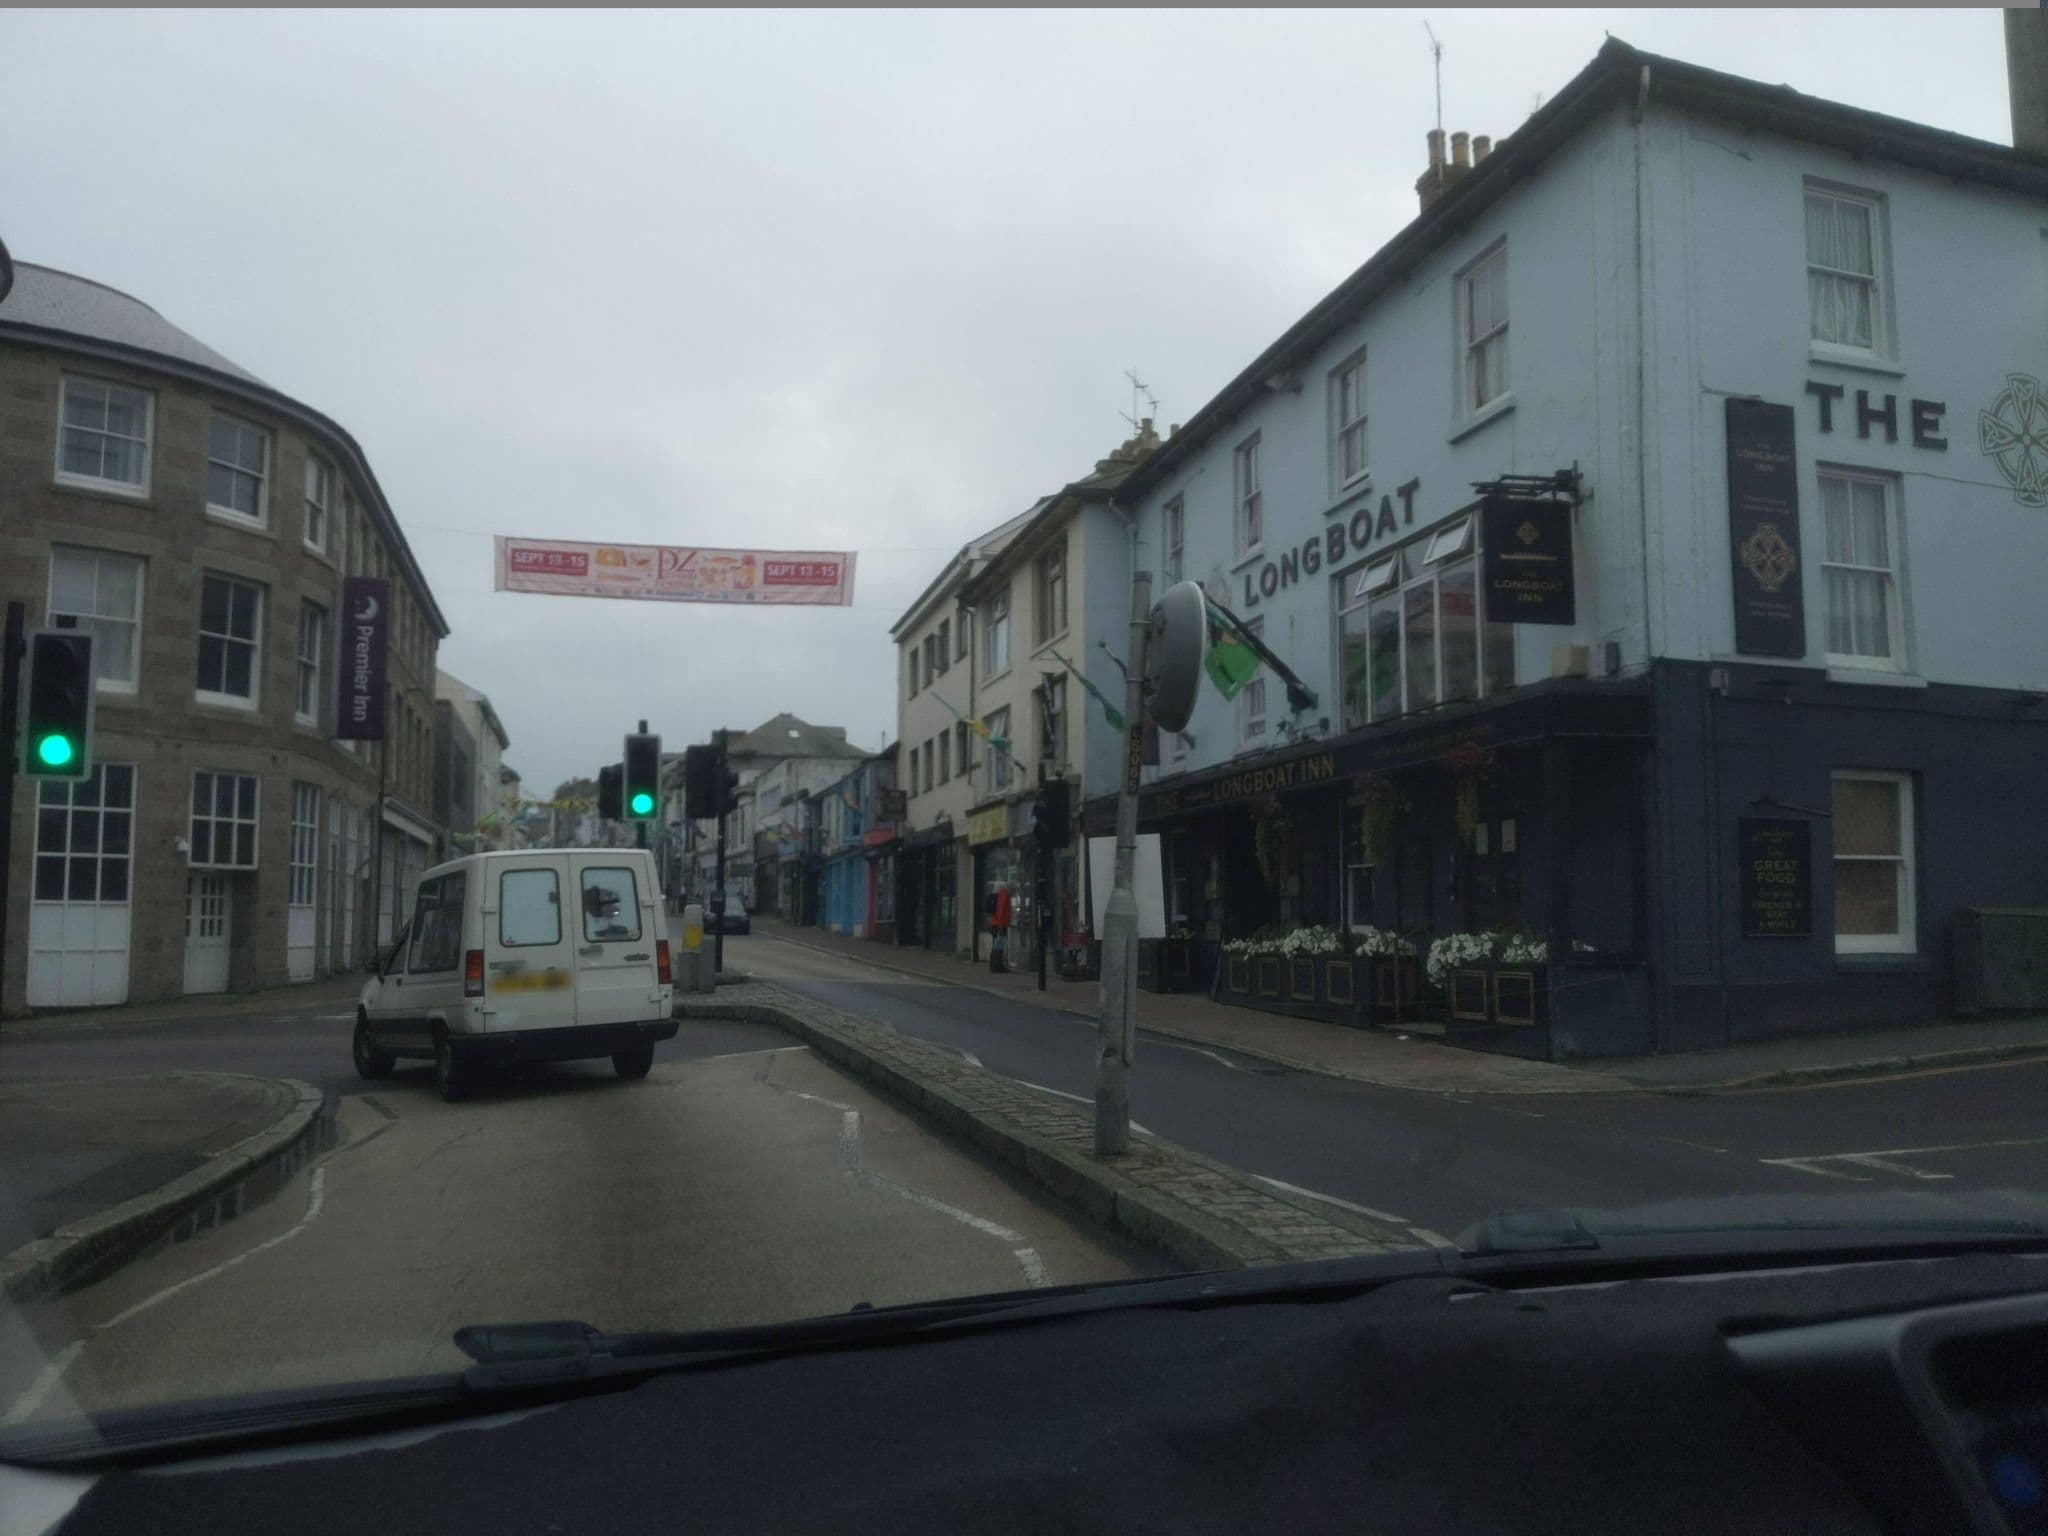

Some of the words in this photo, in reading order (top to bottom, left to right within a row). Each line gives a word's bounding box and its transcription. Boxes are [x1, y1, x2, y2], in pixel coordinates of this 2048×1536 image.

[1806, 379, 1948, 451] THE
[1244, 476, 1420, 608] LONGBOAT
[515, 551, 545, 565] SEPT
[768, 563, 796, 577] SEPT
[1494, 579, 1564, 592] LONGBOAT
[354, 625, 374, 693] Premier
[353, 695, 372, 721] Inn
[1214, 763, 1295, 801] LONGBOAT
[1301, 752, 1335, 782] INN
[1754, 859, 1798, 872] GREAT
